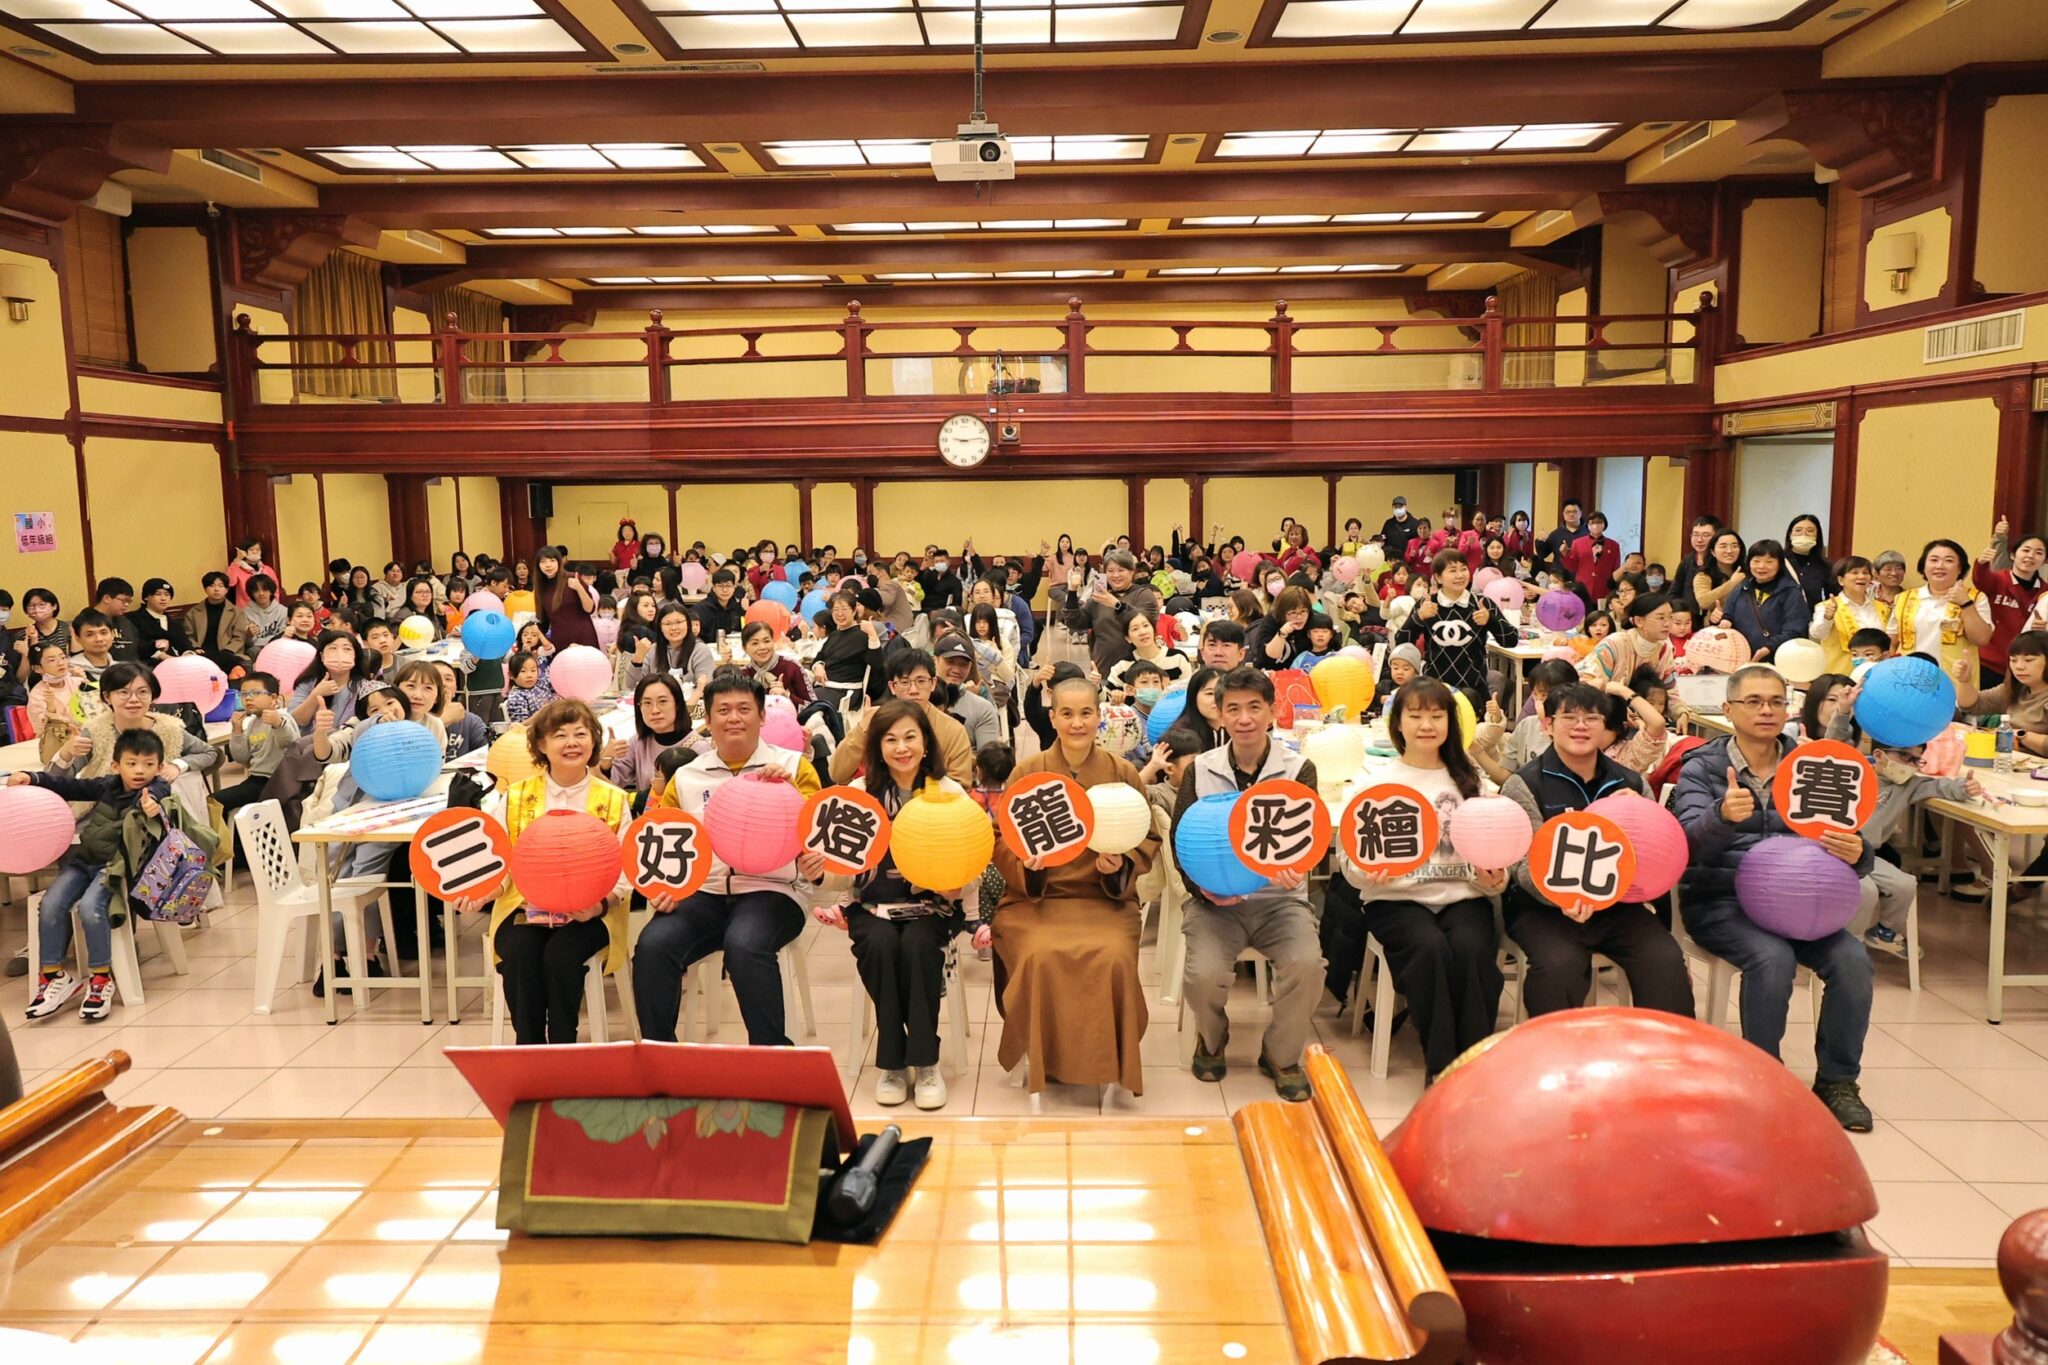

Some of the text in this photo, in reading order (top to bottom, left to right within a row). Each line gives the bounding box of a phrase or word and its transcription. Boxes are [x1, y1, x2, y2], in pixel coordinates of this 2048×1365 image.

[1008, 783, 1084, 855] 籠
[1789, 758, 1861, 828] 賽
[426, 820, 503, 891] 三
[638, 826, 696, 885] 好
[808, 797, 876, 866] 燈
[1246, 799, 1312, 860] 彩
[1358, 800, 1419, 860] 繪
[1547, 826, 1620, 896] 比
